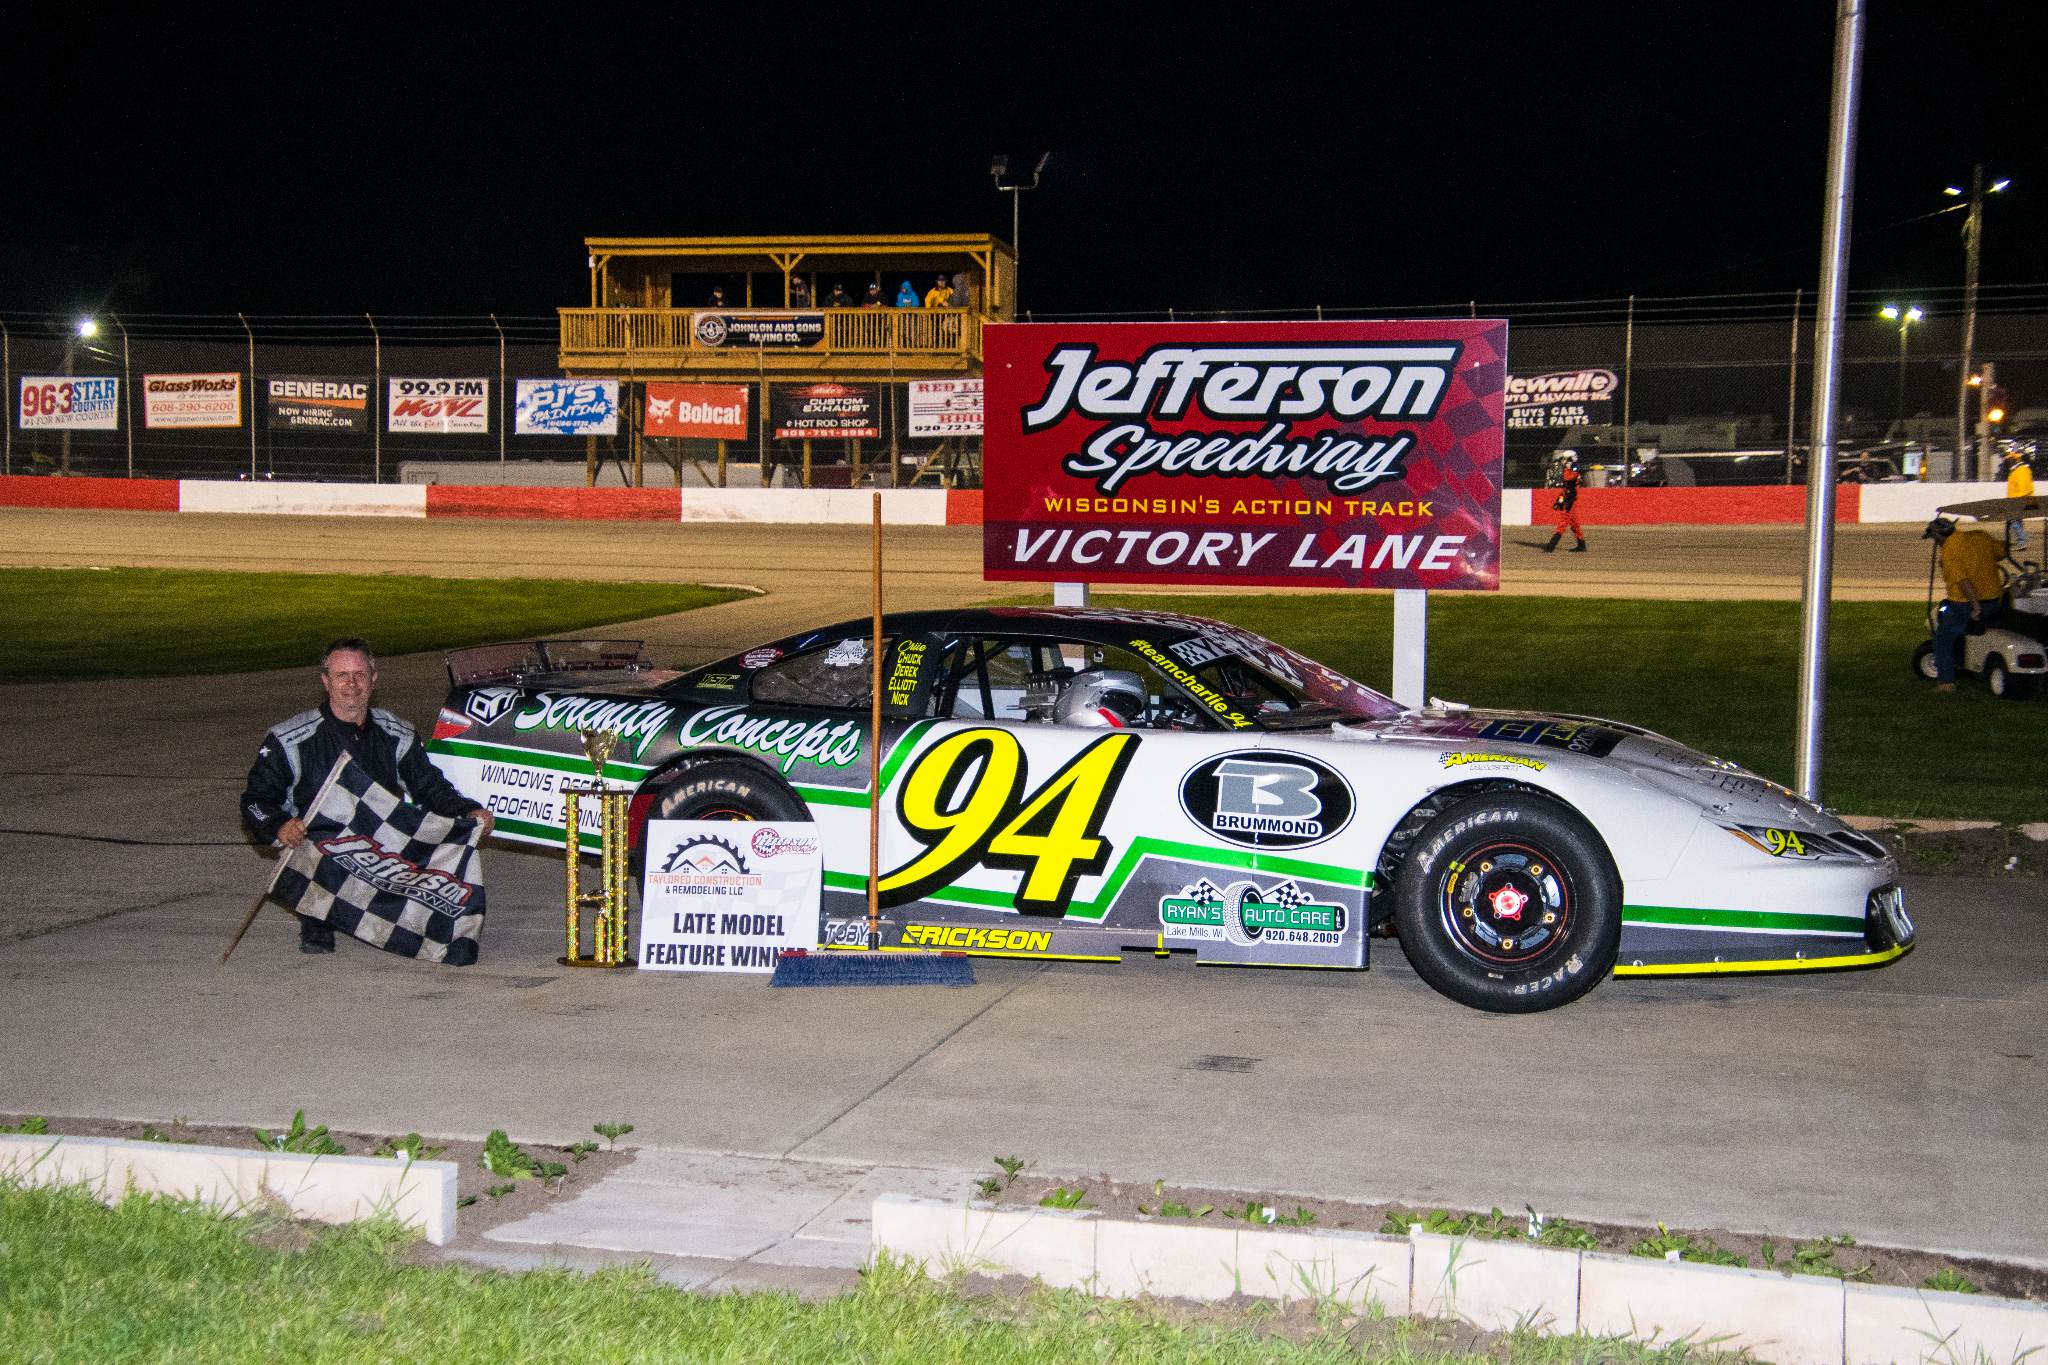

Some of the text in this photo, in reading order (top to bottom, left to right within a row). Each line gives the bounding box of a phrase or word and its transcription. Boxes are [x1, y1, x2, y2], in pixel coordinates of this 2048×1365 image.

[749, 333, 783, 342] PAVING
[774, 323, 793, 333] AND
[796, 323, 822, 332] SONS
[73, 380, 115, 402] STAR
[148, 379, 237, 393] GlassWorks
[269, 380, 367, 399] GENERAC
[400, 381, 483, 395] 99.9 FM
[1025, 345, 1458, 428] Jefferson
[72, 399, 115, 414] COUNTRY
[152, 402, 234, 413] 608-290-6200
[809, 398, 864, 406] CUSTOM
[1533, 392, 1588, 402] SALVAGE
[55, 415, 72, 423] NEW
[74, 411, 114, 422] COUNTRY
[278, 407, 333, 418] NOW HIRING
[679, 401, 742, 425] Bobcat
[803, 404, 870, 413] EXHAUST
[1512, 406, 1585, 418] BUYS CARS
[290, 416, 353, 427] GENERAC.COM
[794, 419, 816, 428] HOT
[816, 419, 838, 428] ROD
[840, 418, 869, 428] SHOP
[1507, 416, 1589, 427] SELLS PARTS
[1069, 422, 1407, 491] Speedway
[1043, 495, 1435, 517] WISCONSIN'S ACTION TRACK
[1012, 528, 1467, 570] VICTORY LANE
[1129, 639, 1228, 713] #teamcharlie
[1223, 712, 1254, 730] 94
[514, 691, 676, 760] Serenity
[679, 704, 861, 773] Concepts
[1443, 752, 1548, 773] AMERICAN
[481, 764, 554, 795] WINDOWS,
[486, 794, 554, 824] ROOFING,
[661, 780, 751, 818] AMERICAN
[870, 727, 1138, 914] 94
[1216, 814, 1319, 836] BRUMMOND
[1417, 810, 1519, 875] AMERICAN
[1765, 828, 1808, 857] 94
[649, 875, 762, 887] TAYLORED CONSTRUCTION
[665, 886, 744, 896] & REMODELING LLC
[672, 912, 786, 936] LATE MODEL
[1167, 905, 1221, 920] RYAN'S
[1245, 908, 1285, 923] AUTO
[1290, 911, 1331, 926] CARE
[901, 924, 1052, 952] ERICKSON
[1166, 926, 1187, 937] Lake
[1212, 928, 1223, 938] WI
[1265, 930, 1340, 944] 920.648.2009
[645, 943, 726, 967] FEATURE
[1514, 953, 1584, 995] RACER
